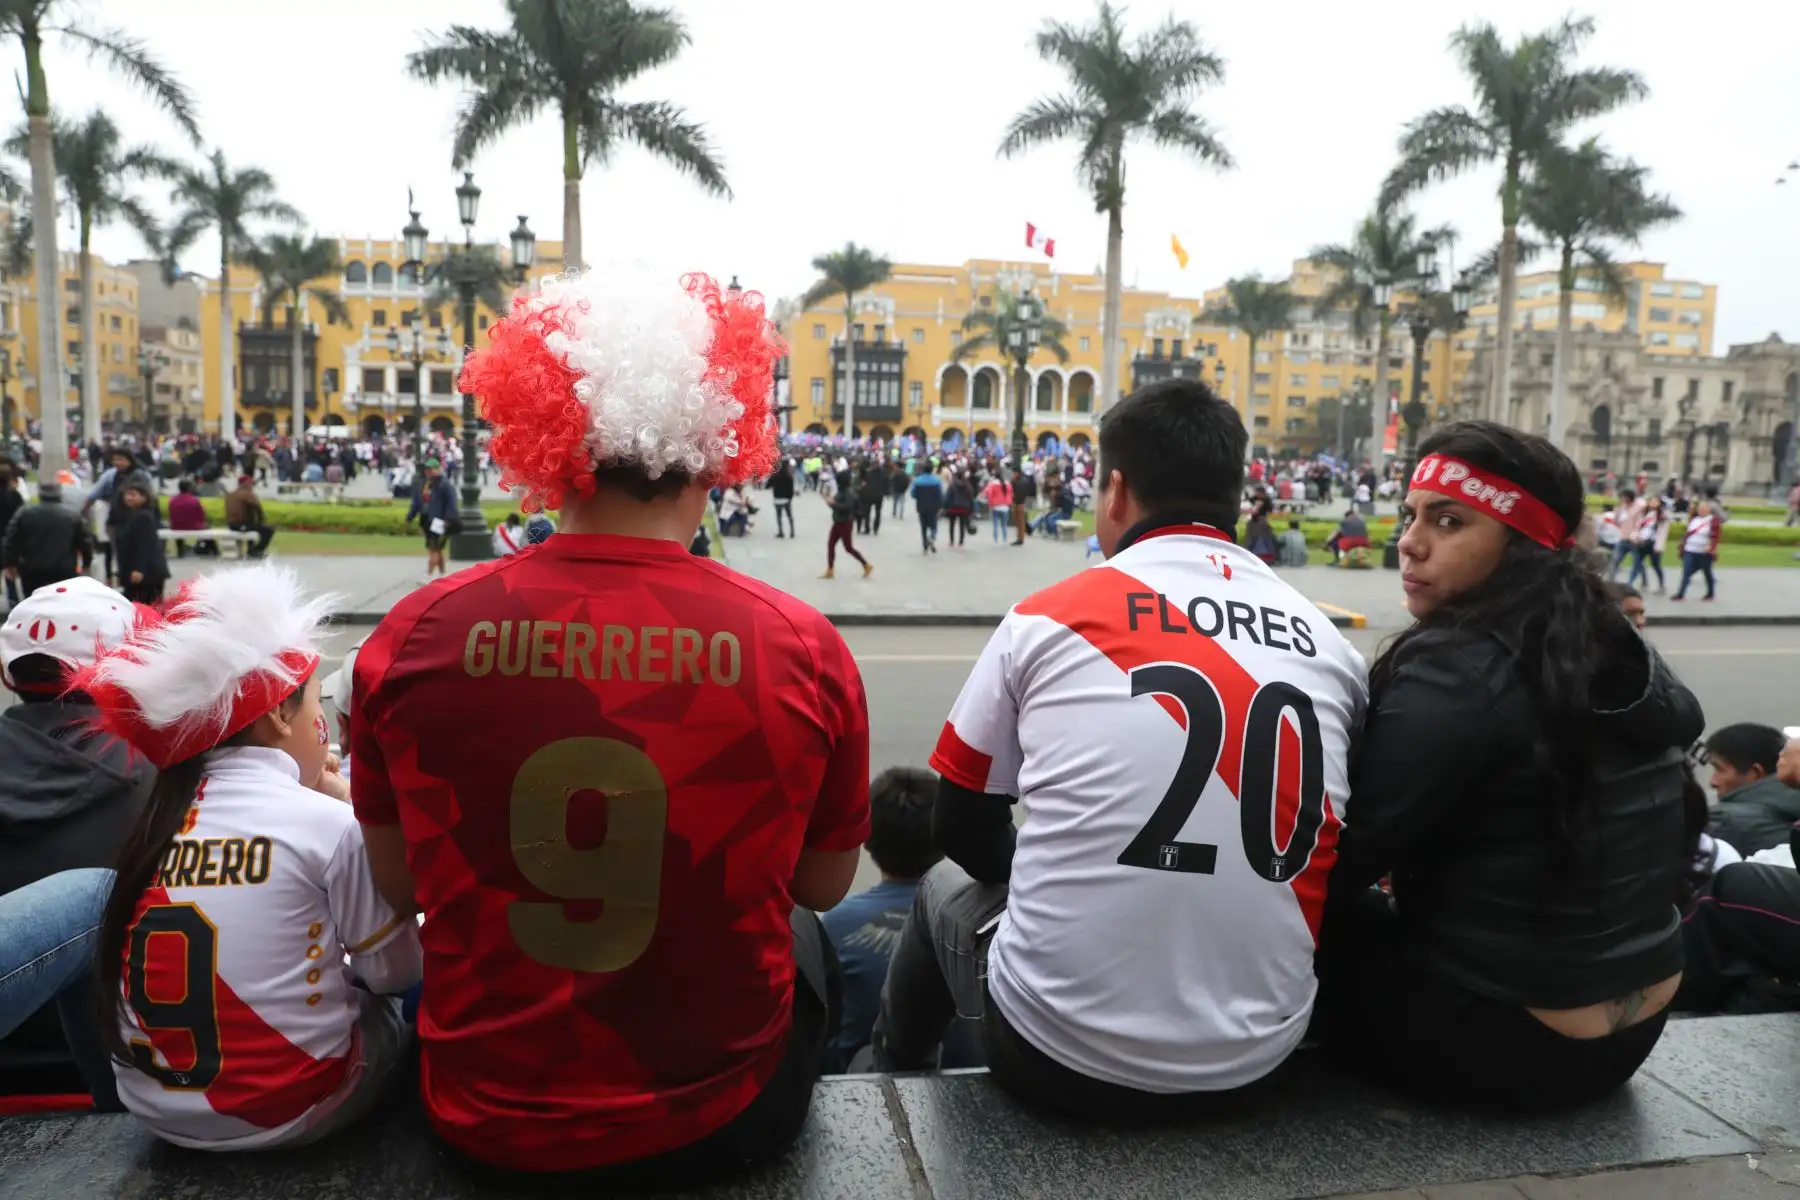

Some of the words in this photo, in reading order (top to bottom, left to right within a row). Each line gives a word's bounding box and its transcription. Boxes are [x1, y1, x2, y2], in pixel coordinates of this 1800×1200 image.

[1439, 461, 1521, 514] Perú
[464, 620, 741, 687] GUERRERO
[1126, 592, 1317, 657] FLORES
[1117, 662, 1325, 883] 20
[150, 836, 272, 888] RRERO
[507, 736, 668, 973] 9
[122, 901, 223, 1091] 9
